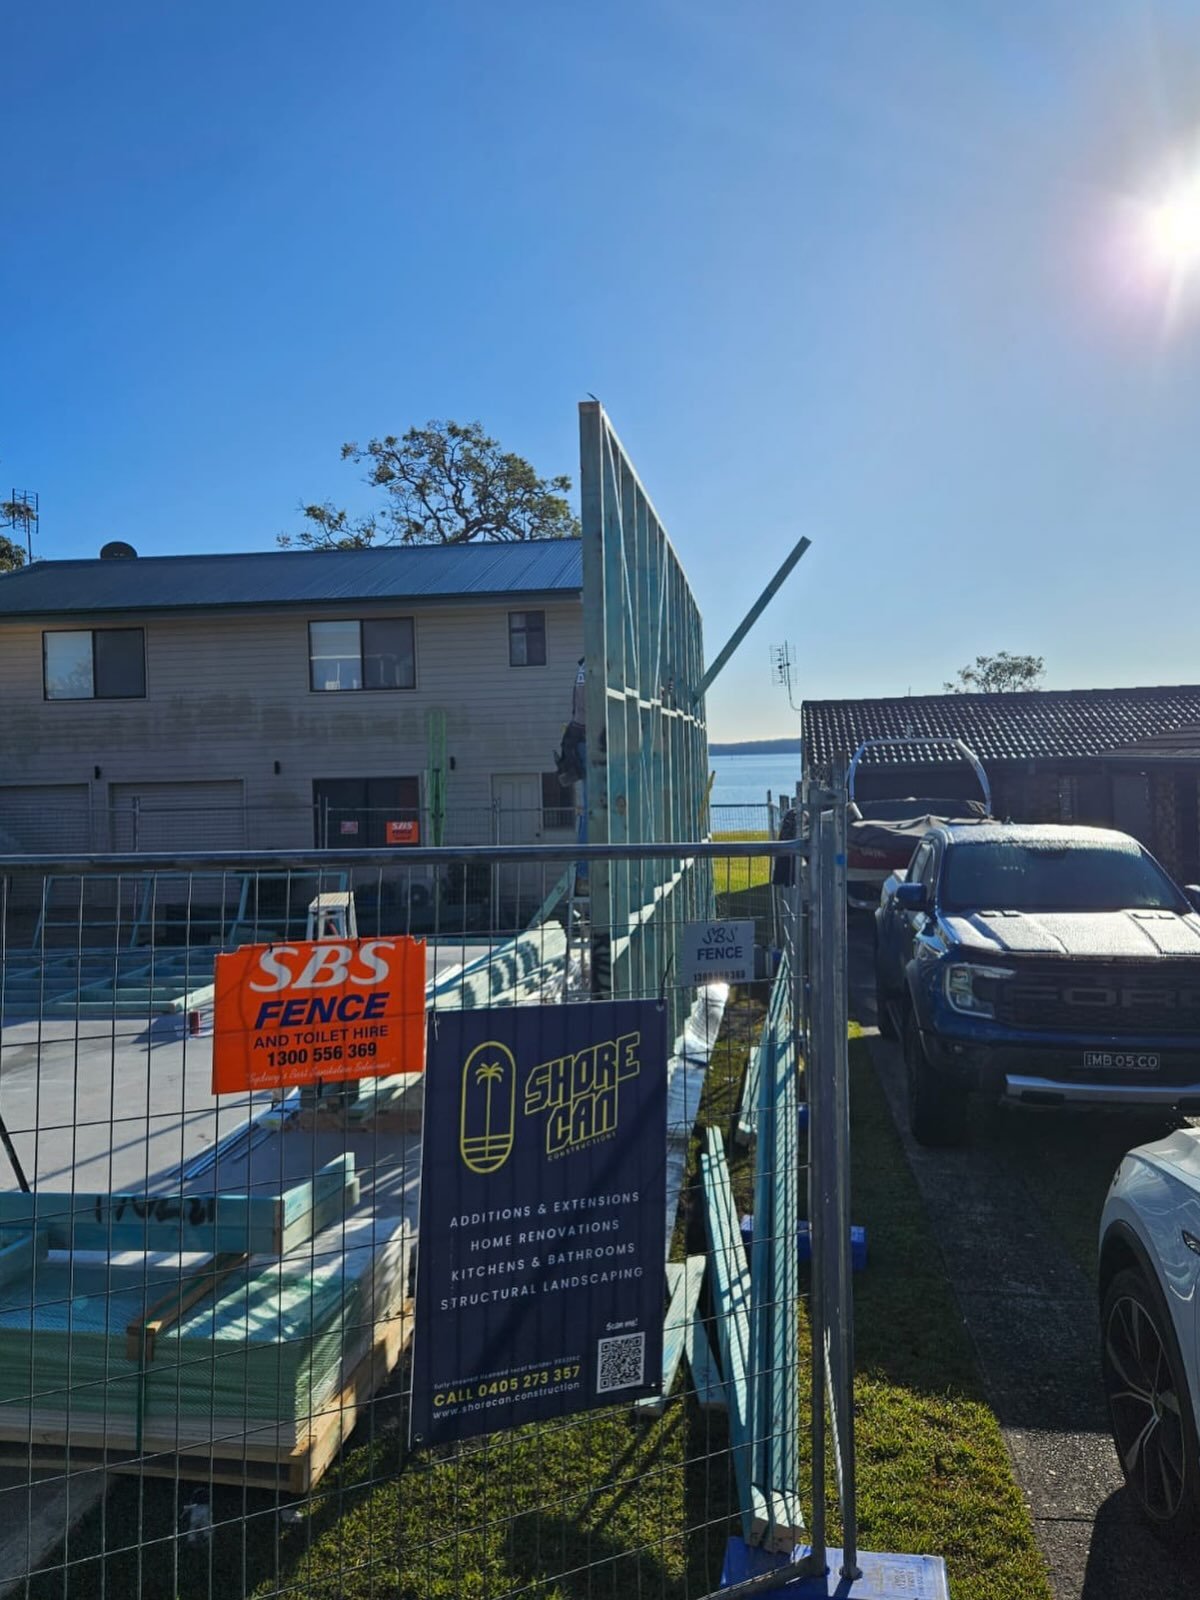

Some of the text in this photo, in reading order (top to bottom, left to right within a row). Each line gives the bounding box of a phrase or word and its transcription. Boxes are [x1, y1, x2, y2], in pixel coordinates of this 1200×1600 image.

[249, 940, 396, 992] SBS
[697, 946, 744, 961] FENCE
[254, 992, 390, 1030] FENCE
[254, 1025, 389, 1050] AND TOILET HIRE
[267, 1042, 377, 1067] 1300 556 369
[524, 1031, 640, 1115] SHORE
[548, 1132, 616, 1161] CONSTRUCTIONS
[450, 1192, 640, 1228] ADDITIONS & EXTENSIONS
[471, 1219, 620, 1252] HOME RENOVATIONS
[451, 1243, 635, 1282] KITCHENS & BATHROOMS
[441, 1267, 643, 1311] STRUCTURAL LANDSCAPING
[434, 1365, 580, 1407] CALL 0405 273 357
